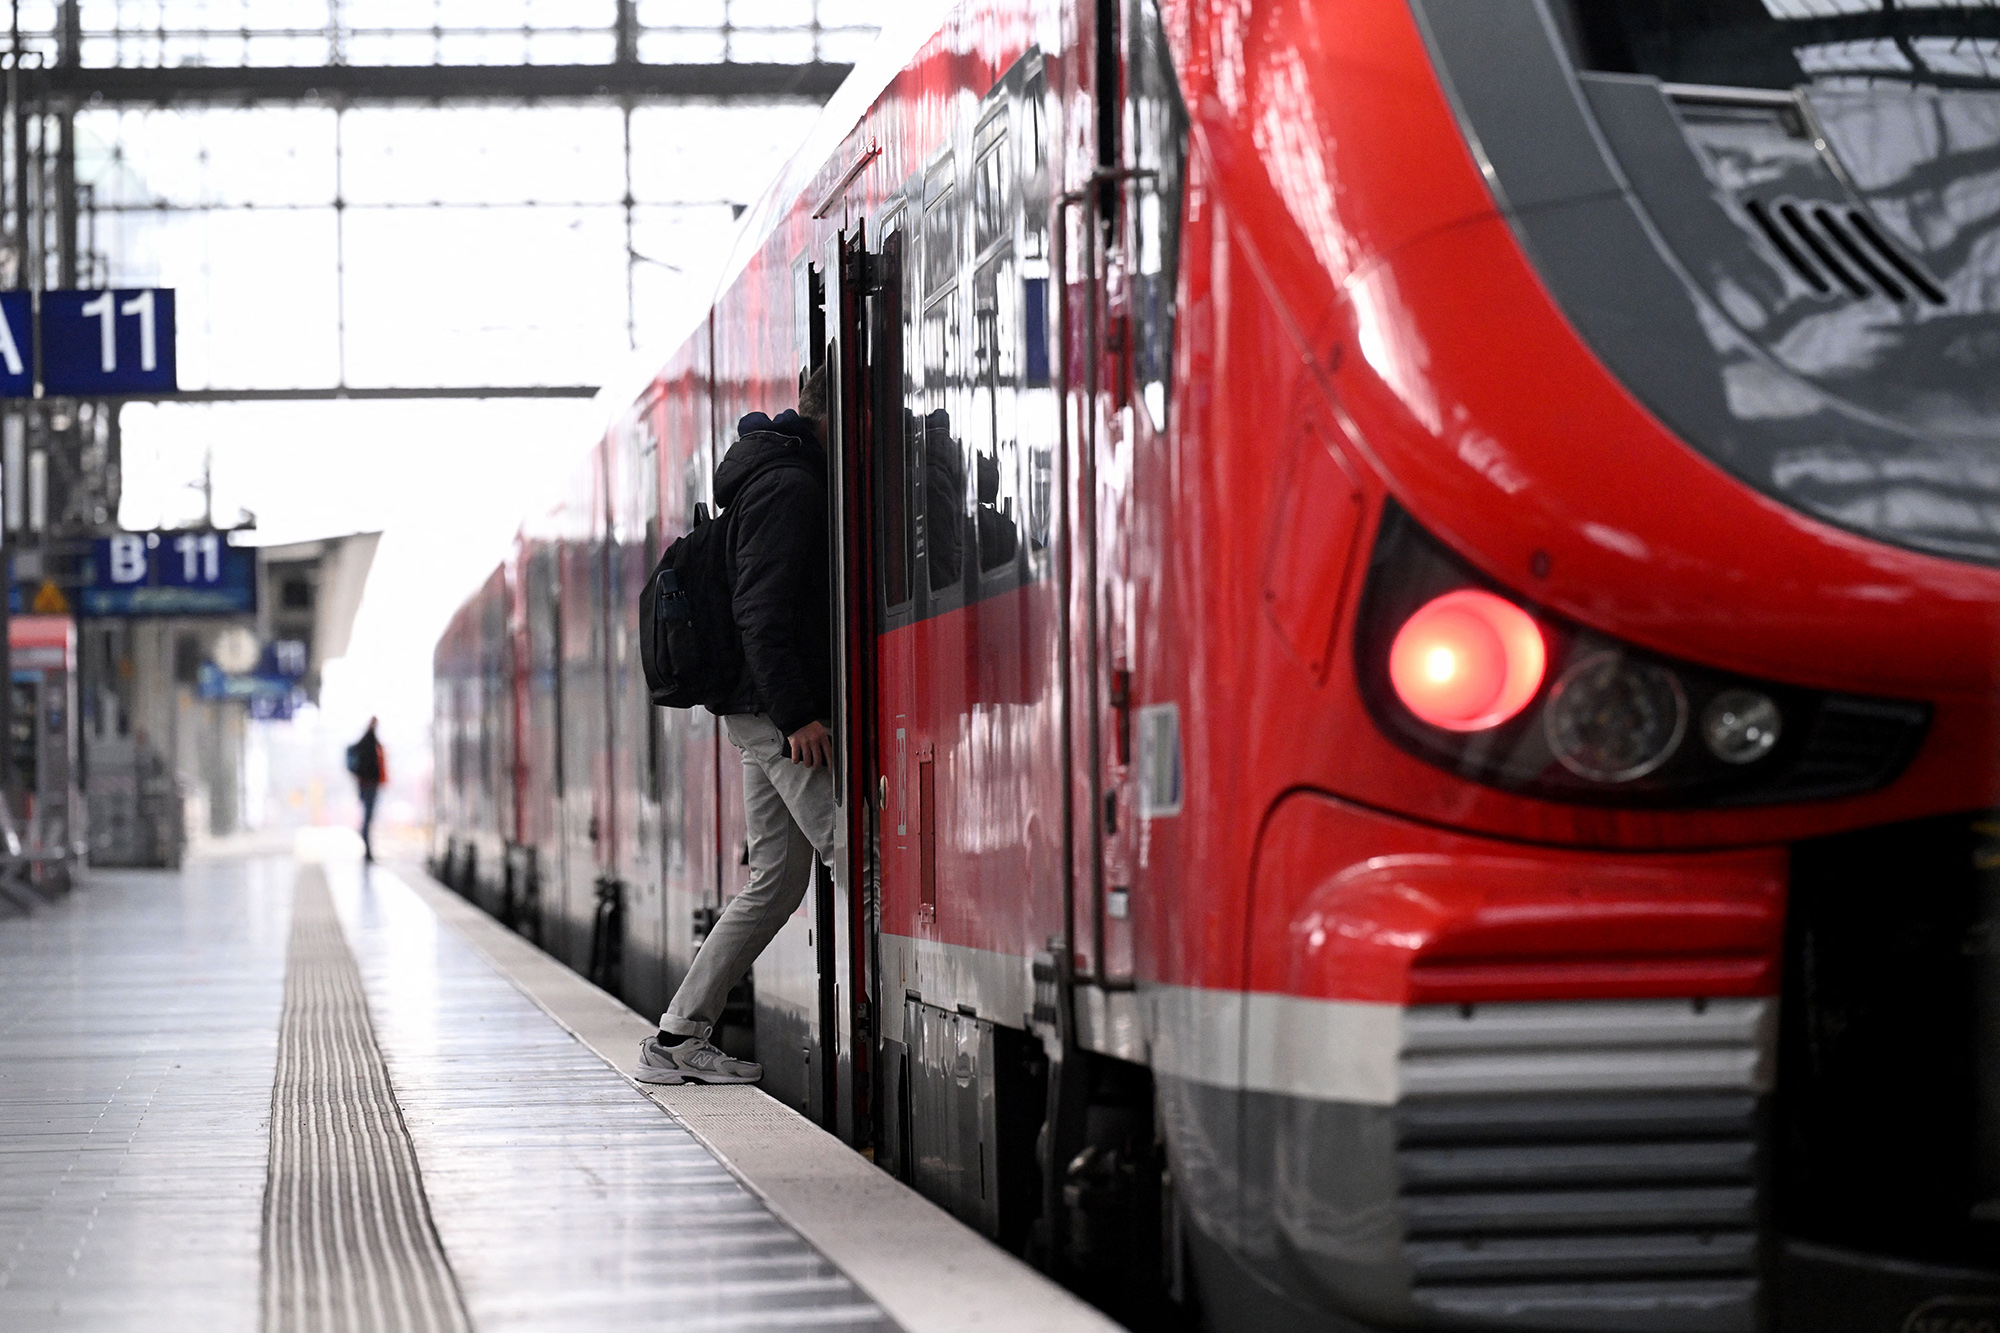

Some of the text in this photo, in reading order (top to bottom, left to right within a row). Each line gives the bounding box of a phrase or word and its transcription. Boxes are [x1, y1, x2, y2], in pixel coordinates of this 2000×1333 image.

[82, 290, 157, 373] 11
[110, 533, 219, 583] B 11
[691, 1052, 712, 1067] N
